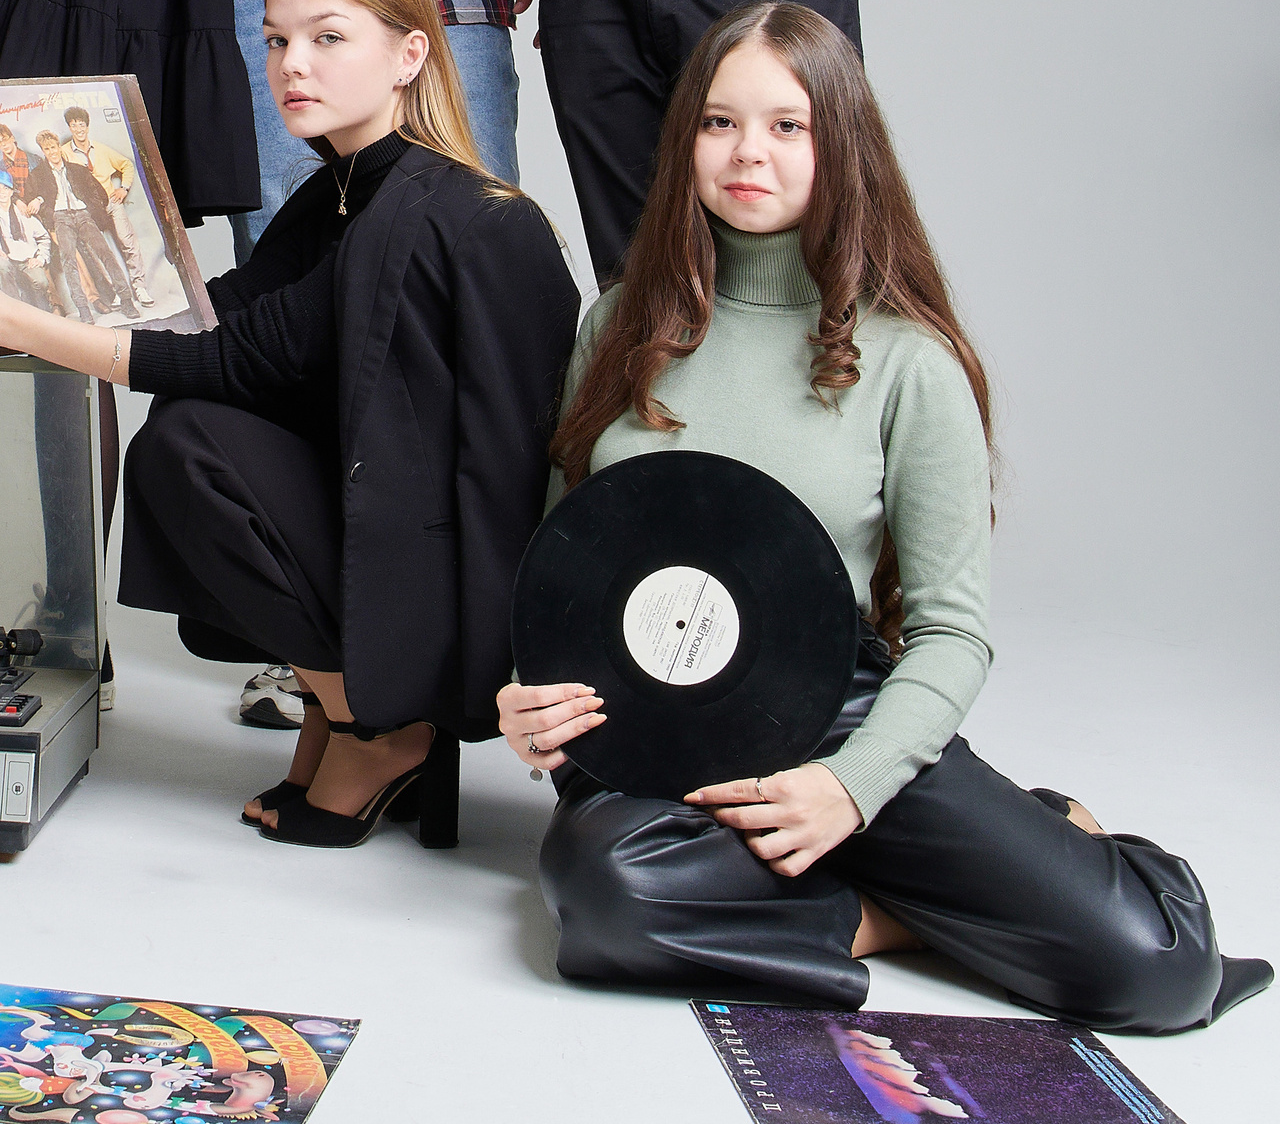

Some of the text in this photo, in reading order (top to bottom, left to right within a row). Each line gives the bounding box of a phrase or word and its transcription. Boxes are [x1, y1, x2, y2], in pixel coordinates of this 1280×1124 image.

[39, 90, 113, 110] РЕБЯТА
[683, 617, 710, 669] МЕЛОДИЯ
[715, 1017, 783, 1112] ПРОВИНЦИЯ
